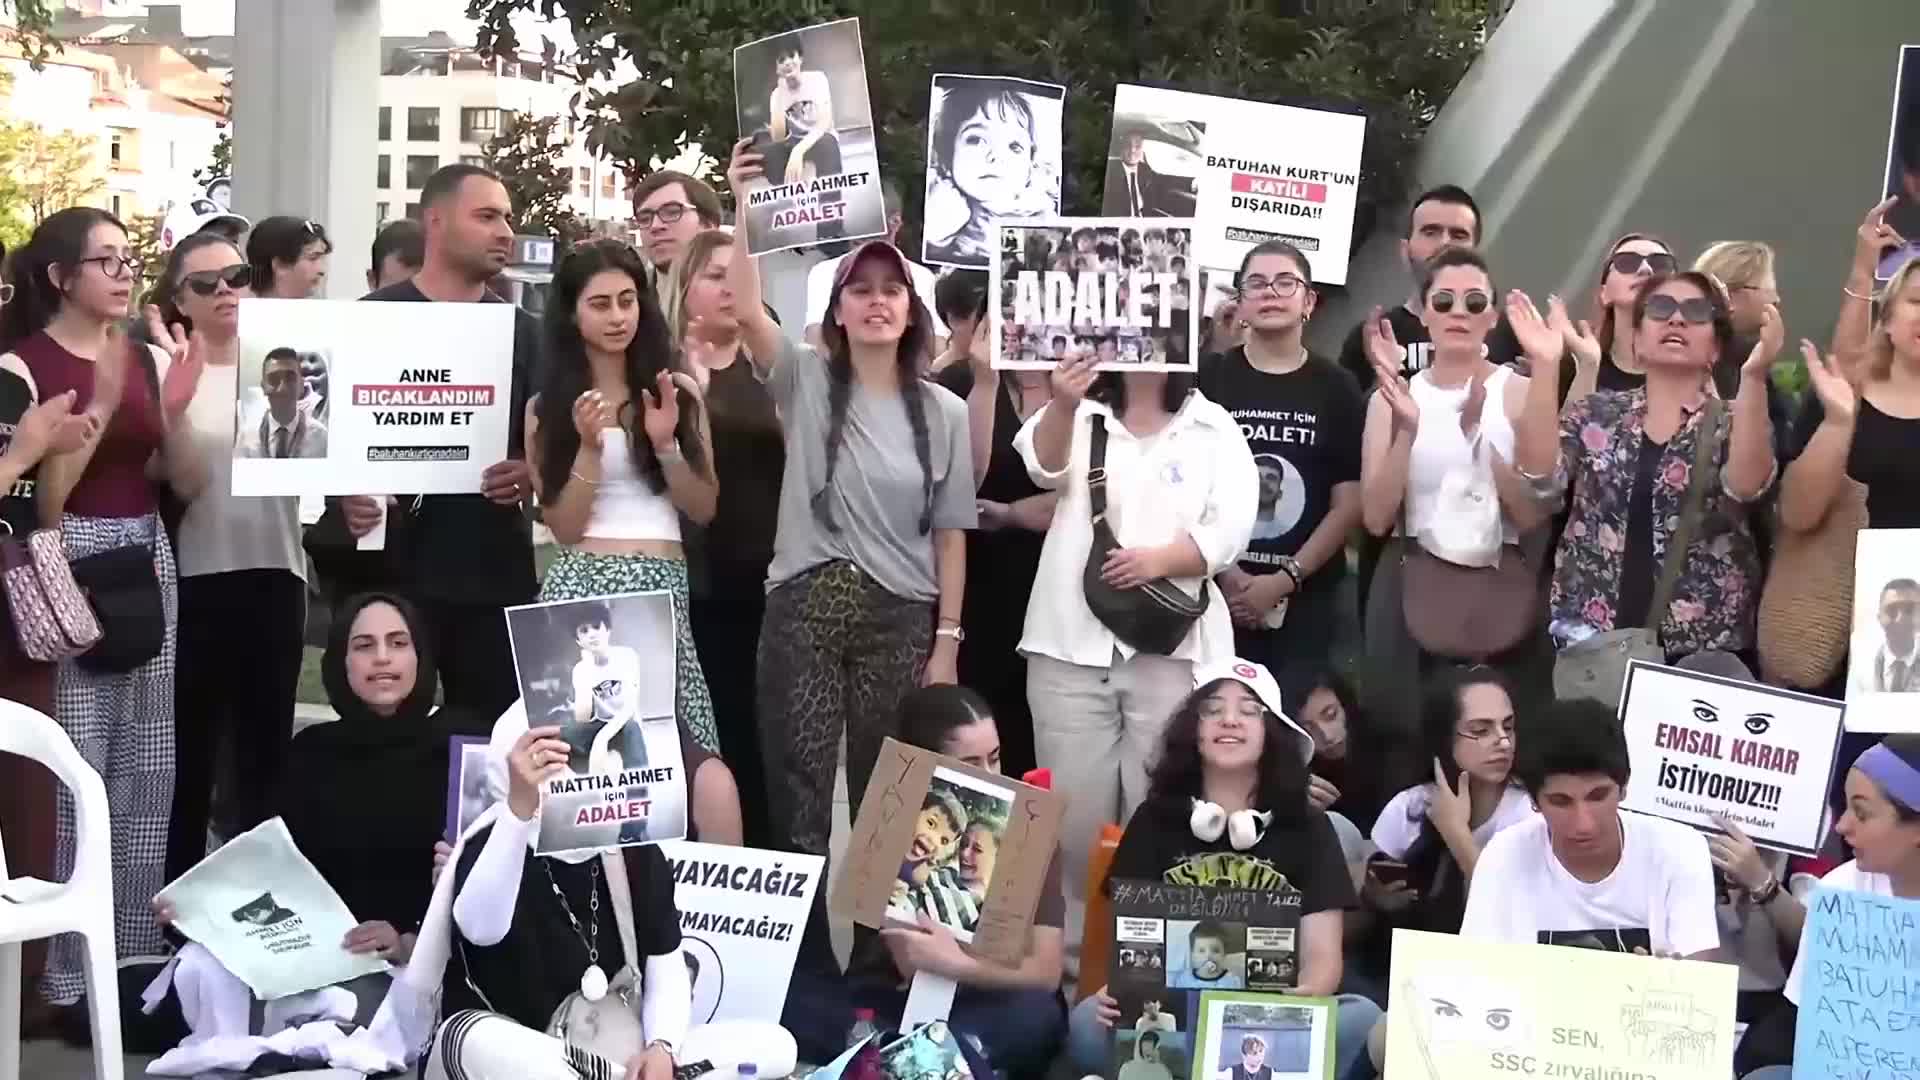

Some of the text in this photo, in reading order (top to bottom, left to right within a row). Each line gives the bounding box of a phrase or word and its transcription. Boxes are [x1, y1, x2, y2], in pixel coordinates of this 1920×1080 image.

[1206, 155, 1355, 186] BATUHAN KURT'UN
[750, 172, 869, 205] MATTIA AHMET
[797, 196, 817, 207] için
[773, 203, 846, 228] ADALET
[1231, 195, 1323, 219] DIŞARIDA!!
[1014, 270, 1178, 328] ADALET
[399, 369, 451, 383] ANNE
[357, 389, 490, 406] BIÇAKLANDIM
[372, 411, 474, 426] YARDIM ET
[1239, 424, 1316, 446] DALET!
[1654, 722, 1800, 775] EMSAL KARAR
[550, 767, 673, 794] MATTIA AHMET
[1657, 757, 1782, 812] İSTİYORUZ!!!
[605, 791, 625, 802] için
[576, 801, 652, 825] ADALET
[668, 858, 809, 898] MAYACAĞIZ
[678, 909, 794, 942] MAYACAĞIZ!
[1816, 893, 1915, 934] MATTIA
[1816, 928, 1914, 968] MUHAM
[1816, 995, 1880, 1032] ATA
